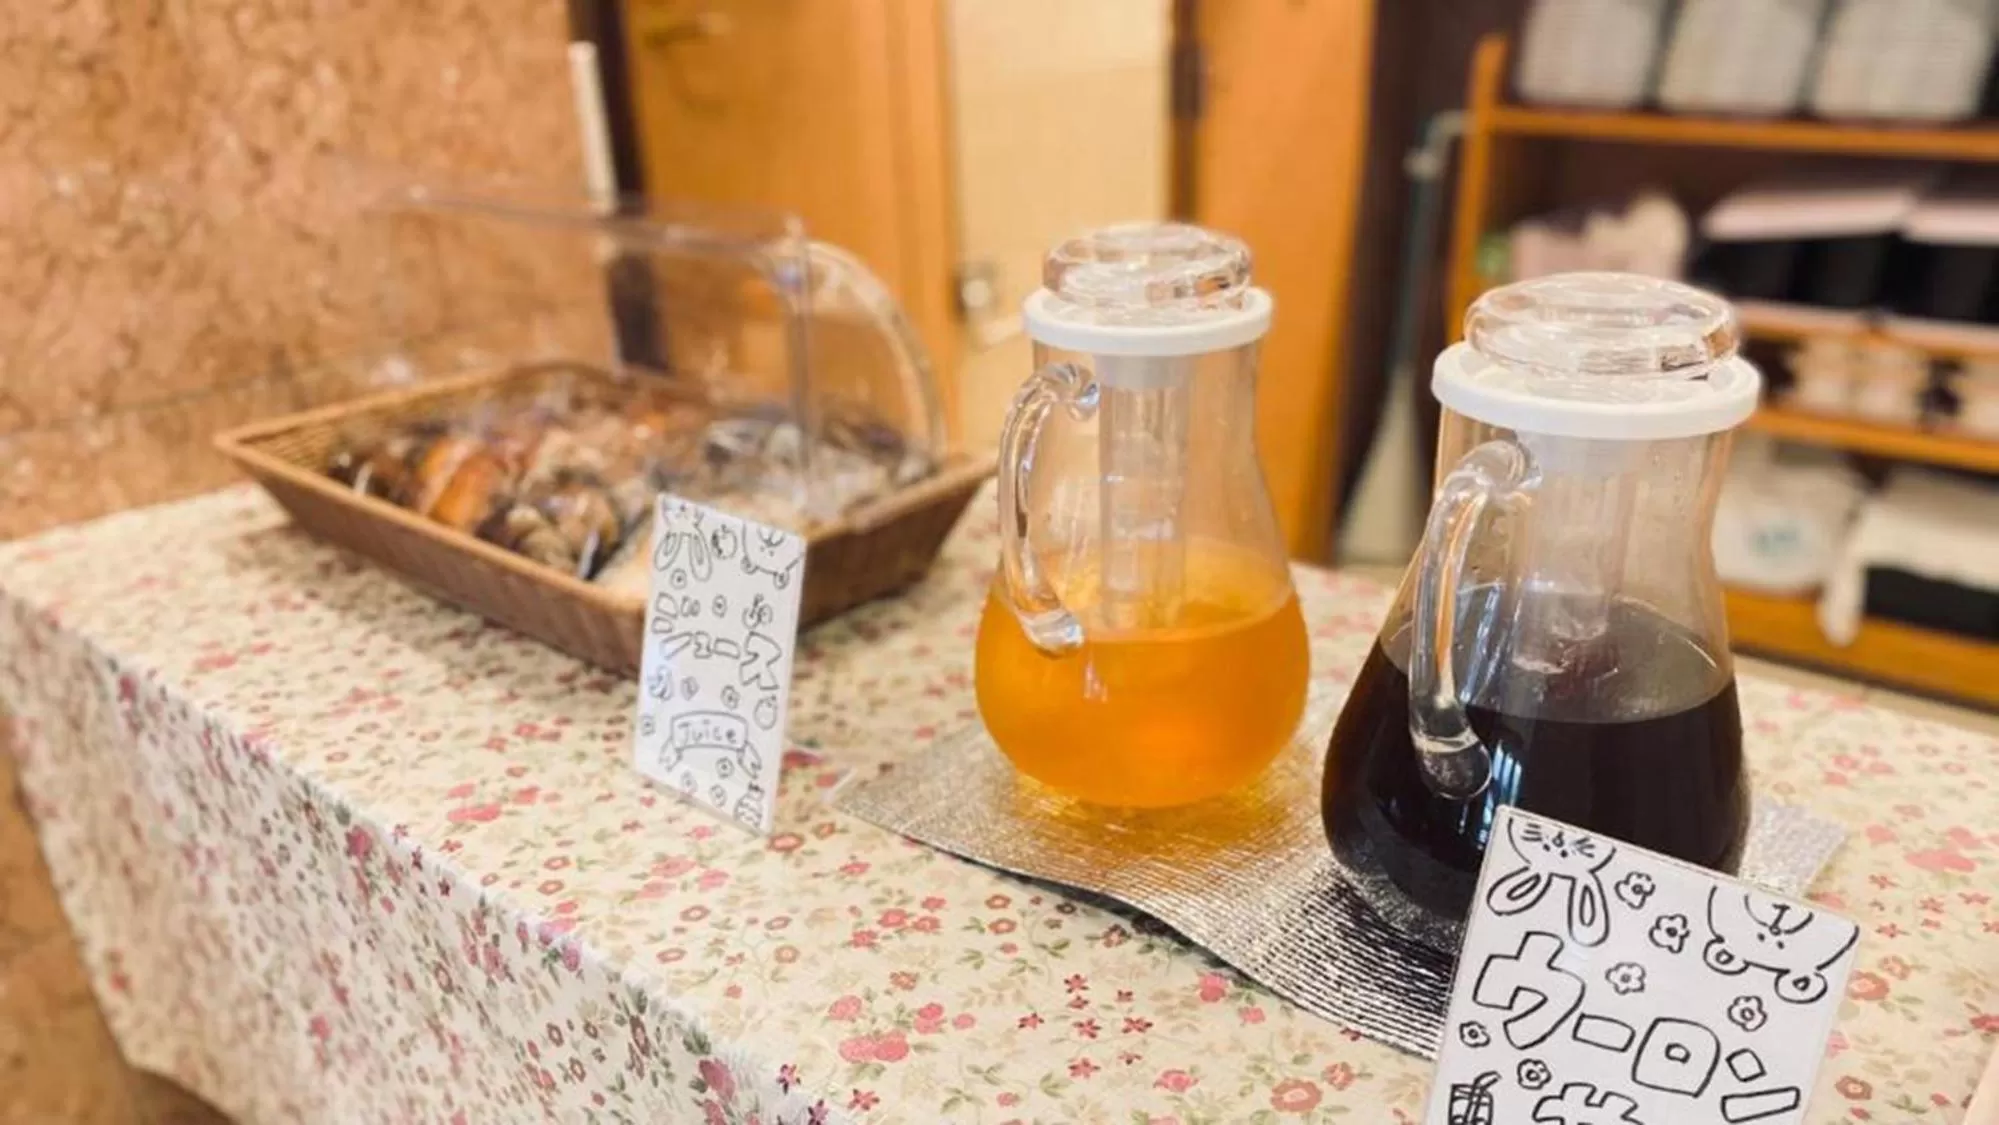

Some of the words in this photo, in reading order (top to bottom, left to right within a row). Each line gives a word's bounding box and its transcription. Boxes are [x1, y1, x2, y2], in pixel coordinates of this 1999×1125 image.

[651, 592, 783, 691] ジュース
[1472, 931, 1801, 1124] ウーロン
